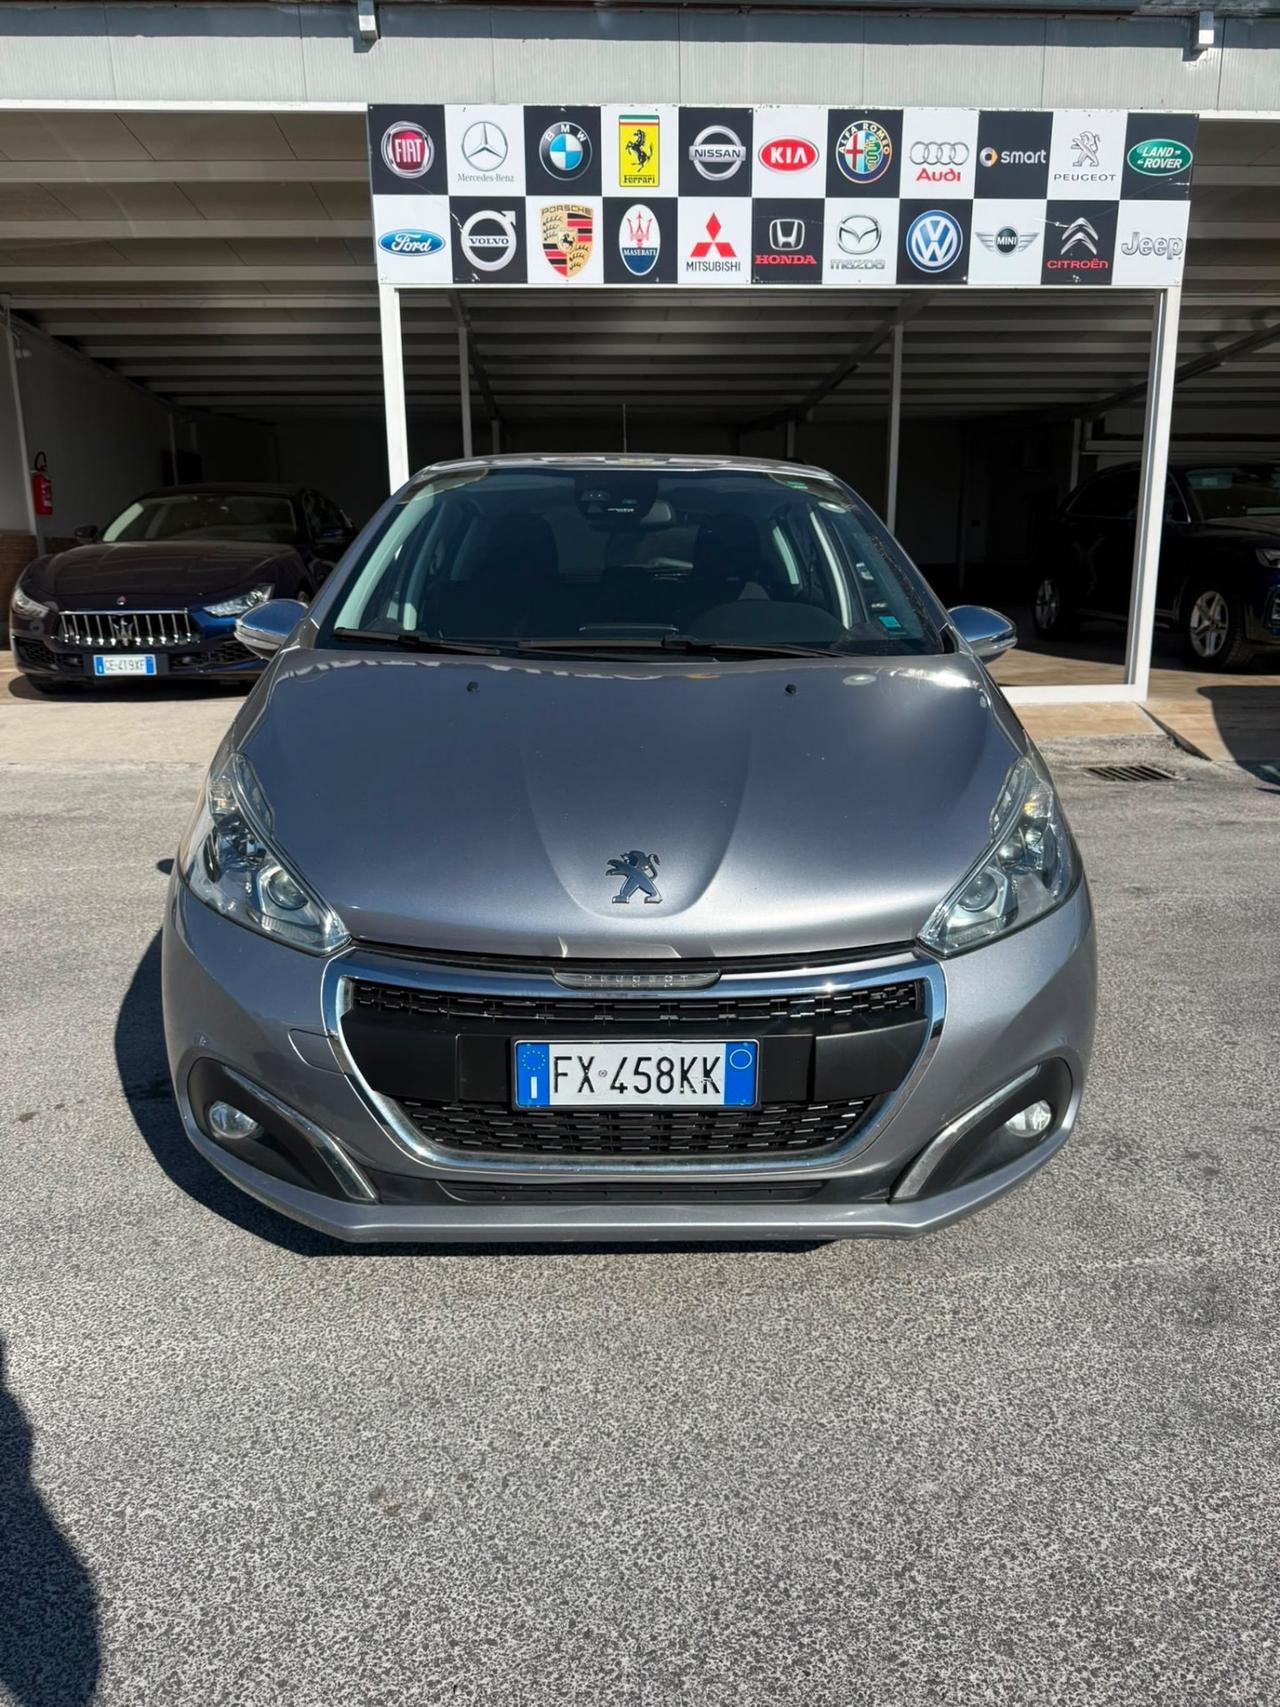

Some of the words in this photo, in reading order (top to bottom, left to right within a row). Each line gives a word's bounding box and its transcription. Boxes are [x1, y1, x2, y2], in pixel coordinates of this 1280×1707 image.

[838, 126, 858, 154] ALFA
[863, 123, 890, 155] ROMEO
[395, 138, 422, 162] FIAT
[694, 150, 741, 158] NISSAN
[770, 147, 808, 163] KIA
[1000, 149, 1047, 164] smart
[623, 174, 656, 184] Ferrari
[915, 168, 961, 182] Audi
[1053, 174, 1116, 182] PEUGEOT
[541, 205, 592, 215] PORSCHE
[391, 234, 432, 253] Ford
[469, 238, 509, 246] VOLVO
[997, 236, 1017, 246] MINI
[1121, 232, 1184, 259] Jeep
[623, 249, 656, 257] MASERATI
[755, 255, 817, 265] HONDA
[686, 261, 741, 272] MITSUBISHI
[553, 1055, 596, 1094] FX
